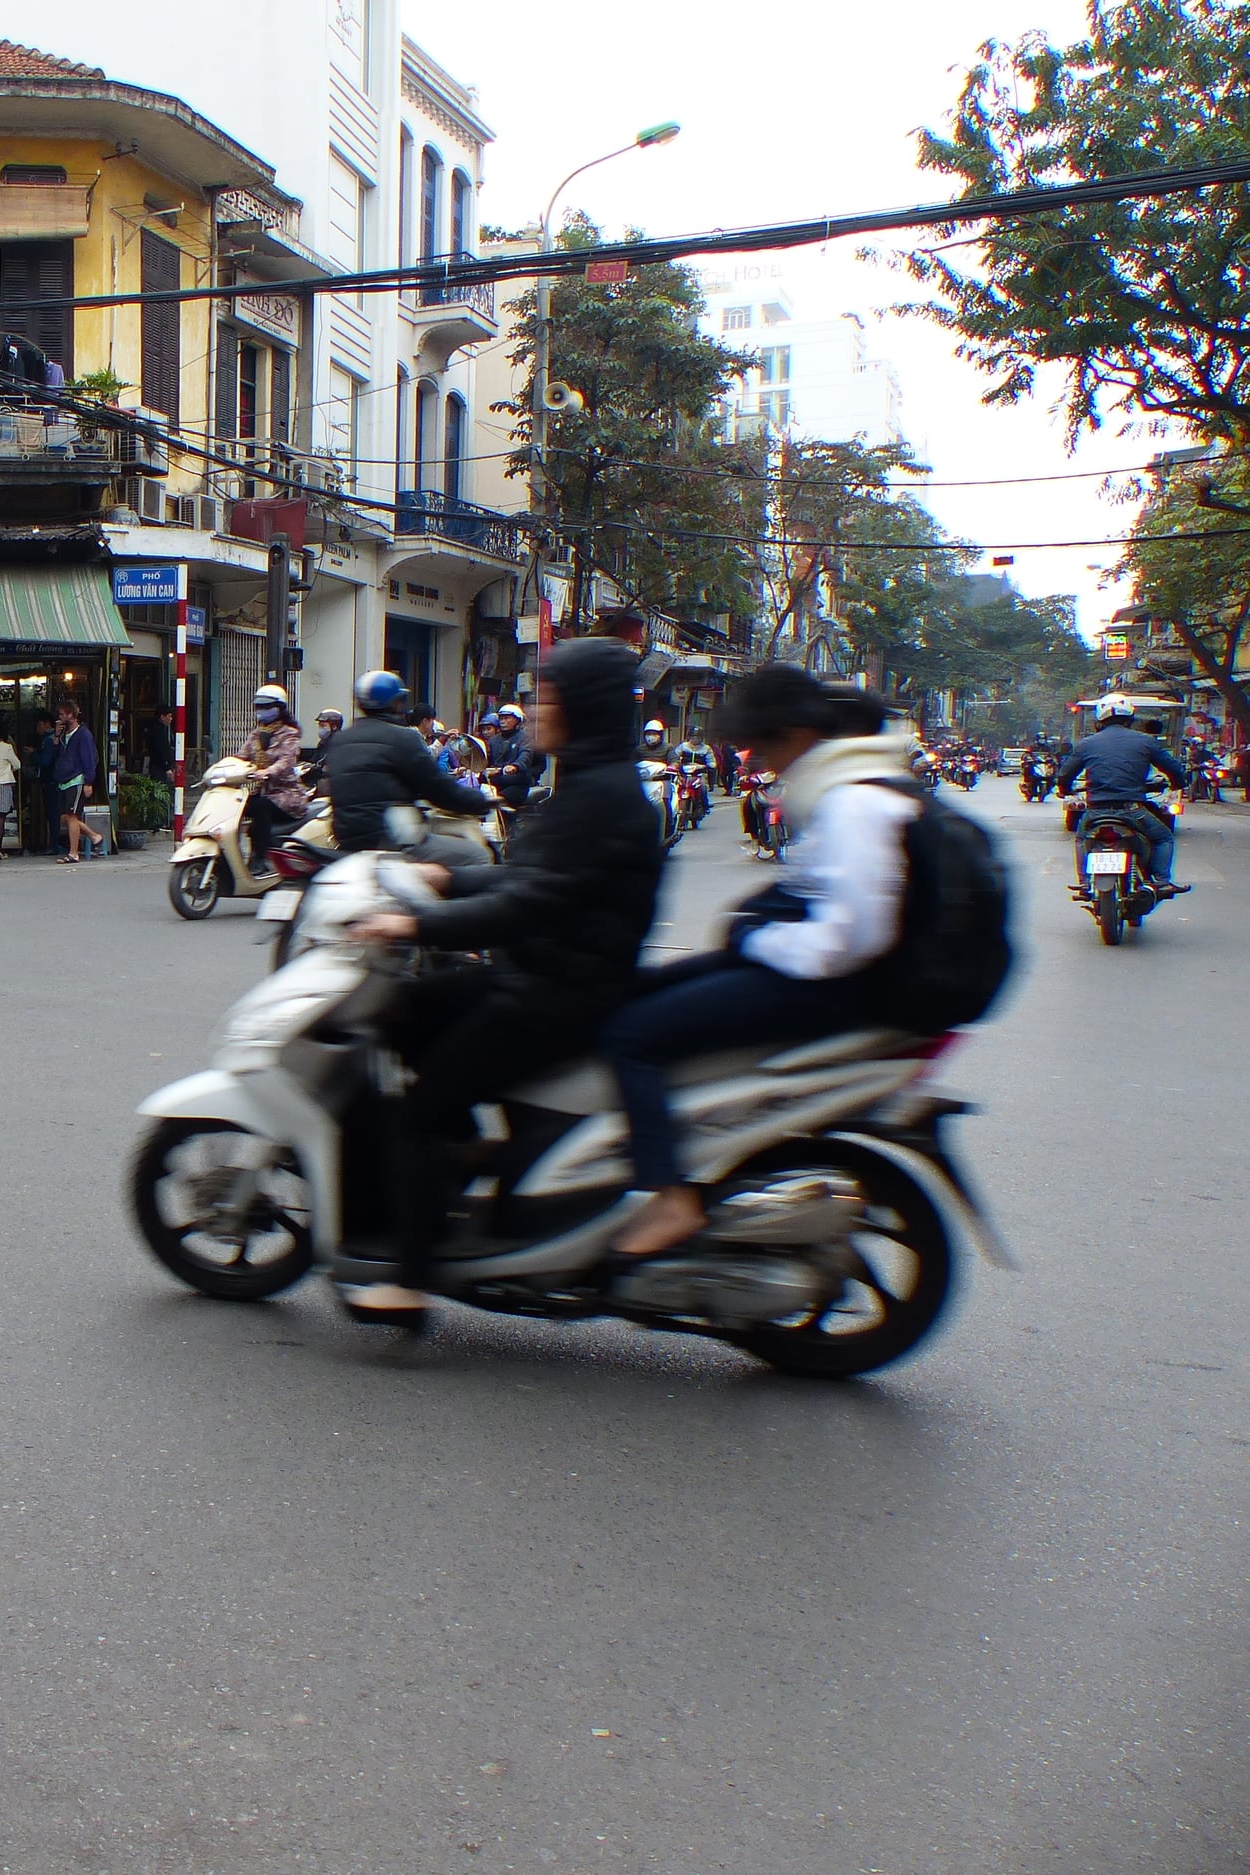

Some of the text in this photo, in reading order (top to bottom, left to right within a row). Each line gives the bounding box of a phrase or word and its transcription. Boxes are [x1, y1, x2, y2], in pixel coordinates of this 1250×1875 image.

[734, 264, 783, 281] HOTEL
[142, 571, 161, 580] PHỐ
[158, 584, 174, 598] CAN
